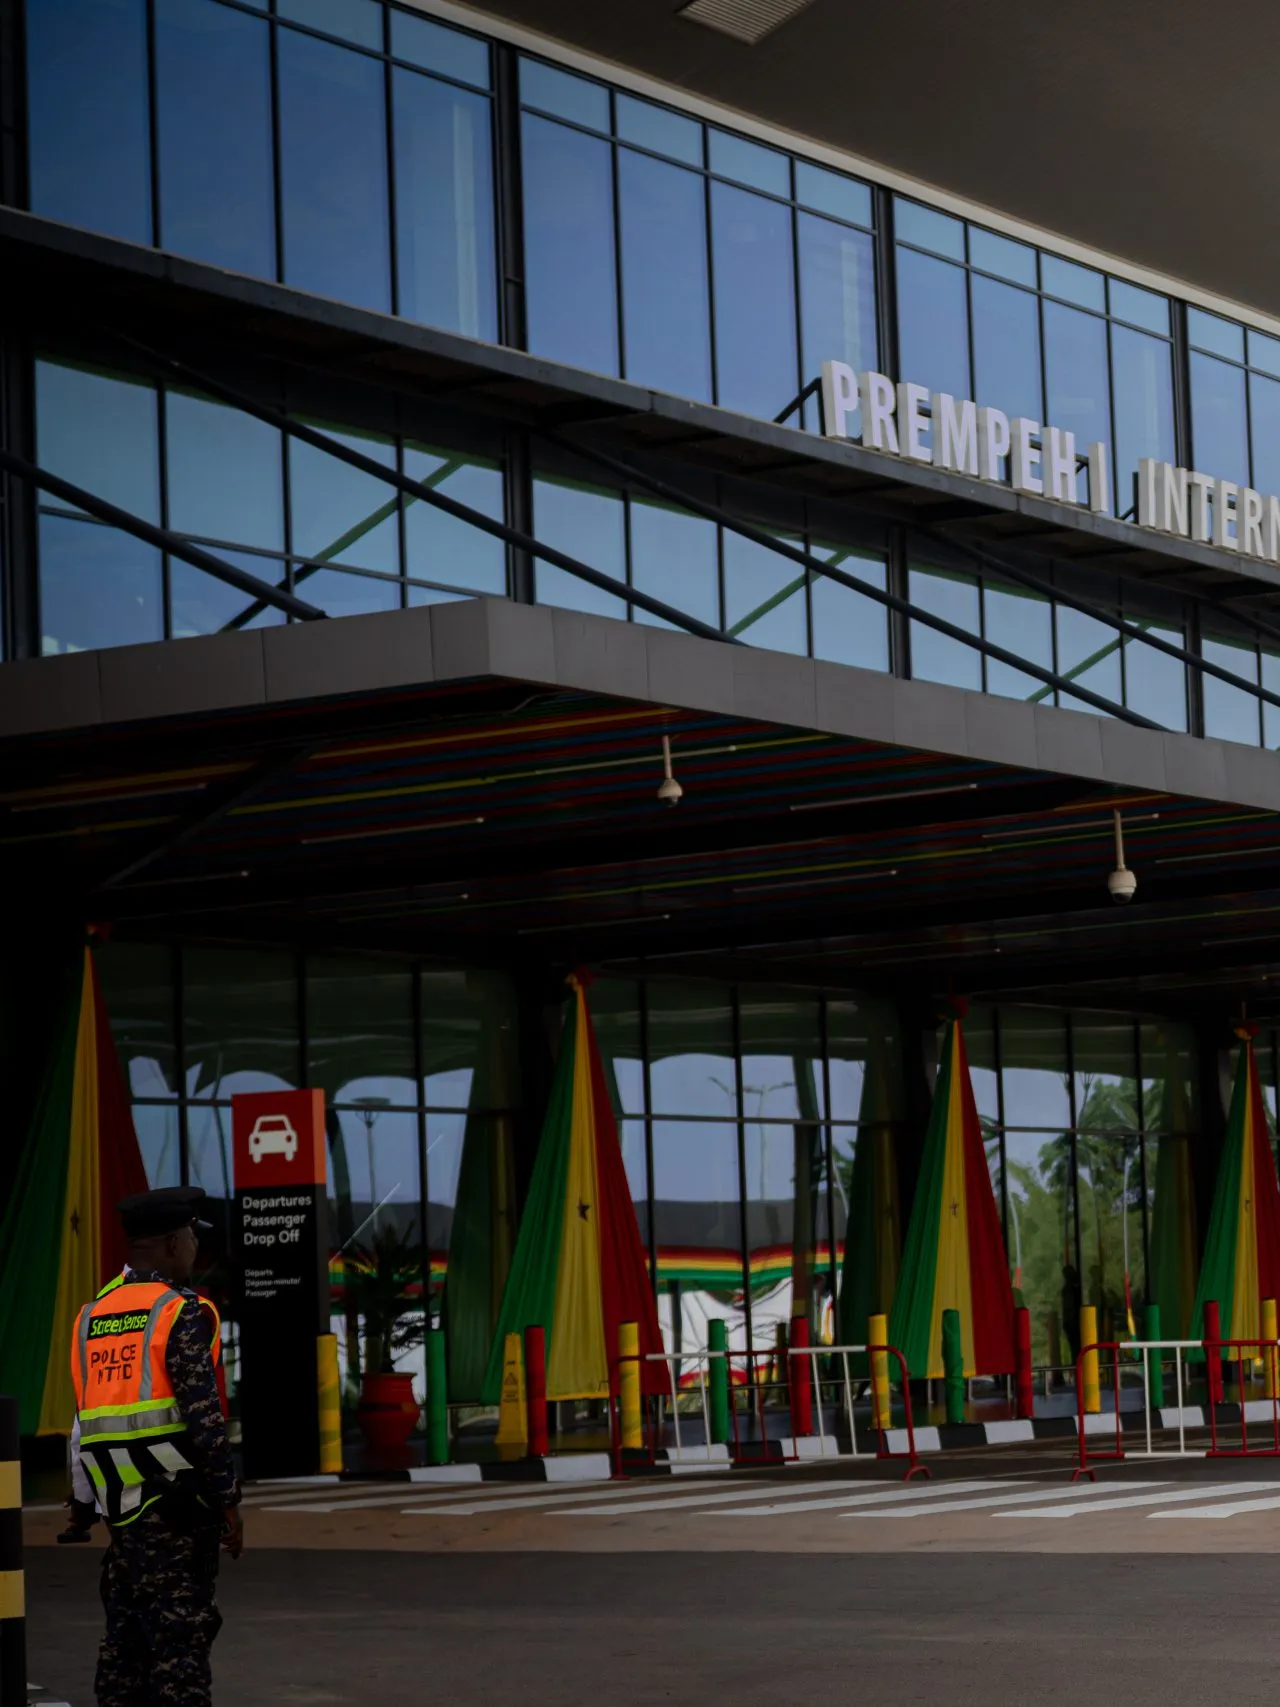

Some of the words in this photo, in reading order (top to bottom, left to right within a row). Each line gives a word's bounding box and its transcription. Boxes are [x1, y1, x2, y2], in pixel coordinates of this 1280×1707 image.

[821, 360, 1077, 502] PREMPEH
[1088, 442, 1108, 512] I
[242, 1195, 312, 1212] Departures
[243, 1213, 307, 1228] Passenger
[244, 1232, 276, 1247] Drop
[278, 1228, 300, 1243] Off
[91, 1344, 136, 1368] POLCE
